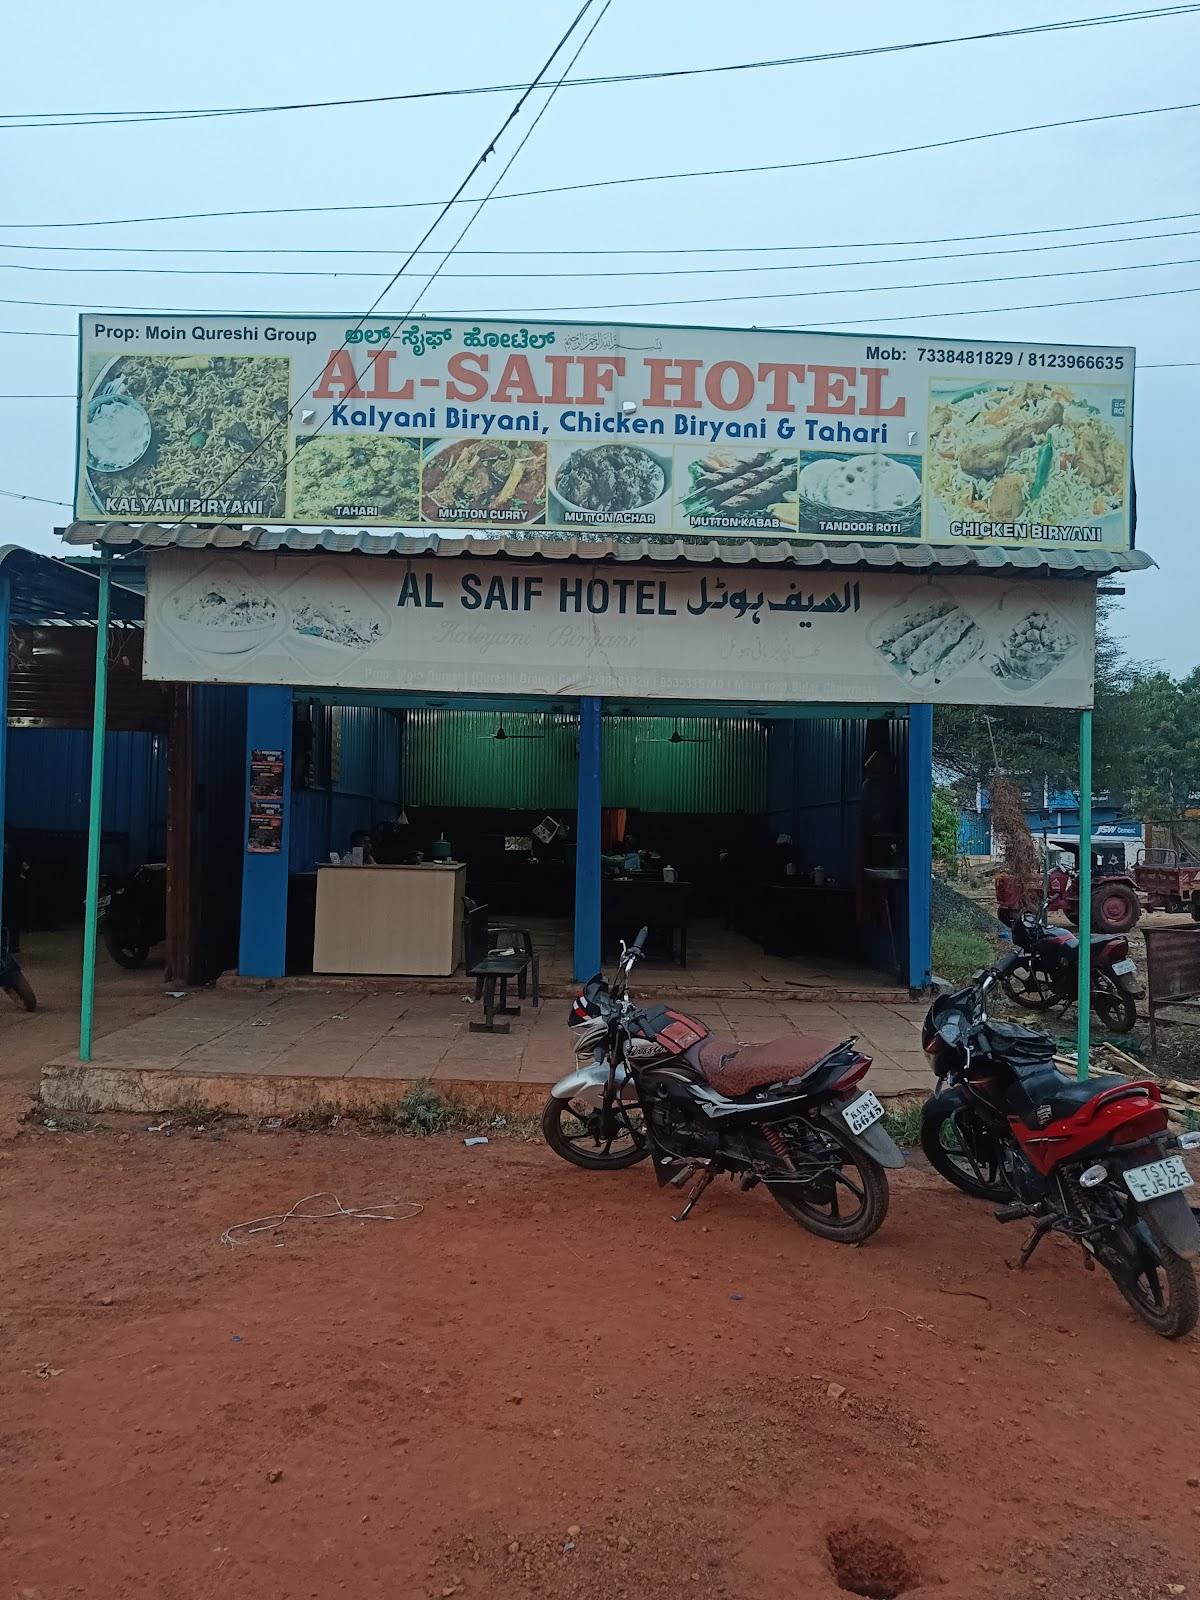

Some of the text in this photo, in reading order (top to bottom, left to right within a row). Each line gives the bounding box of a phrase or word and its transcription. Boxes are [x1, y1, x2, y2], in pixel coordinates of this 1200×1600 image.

[94, 324, 317, 345] Prop: Moin Qureshi Group
[463, 327, 556, 350] ಹೋಟೆಲ್
[866, 345, 1125, 370] Mob: 7338481829 / 8123966635
[312, 348, 906, 417] AL-SAIF HOTEL
[332, 404, 888, 444] Kalyani Biryani, Chicken Biryani & Tahari
[105, 497, 263, 514] KALYANI BIRYANI
[335, 506, 379, 517] TAHARI
[438, 508, 528, 521] MUTTON CURRY
[564, 512, 656, 524] MUTTON ACHAR
[690, 516, 780, 529] MUTTON KABAB
[819, 521, 902, 533] TANDOOR ROTI
[950, 521, 1103, 542] CHICKEN BIRYANI
[397, 572, 677, 616] AL SAIF HOTEL
[1095, 825, 1117, 835] JSW
[852, 1103, 882, 1131] 6645
[1141, 1160, 1176, 1181] TS15
[1139, 1171, 1191, 1198] EJ5425
